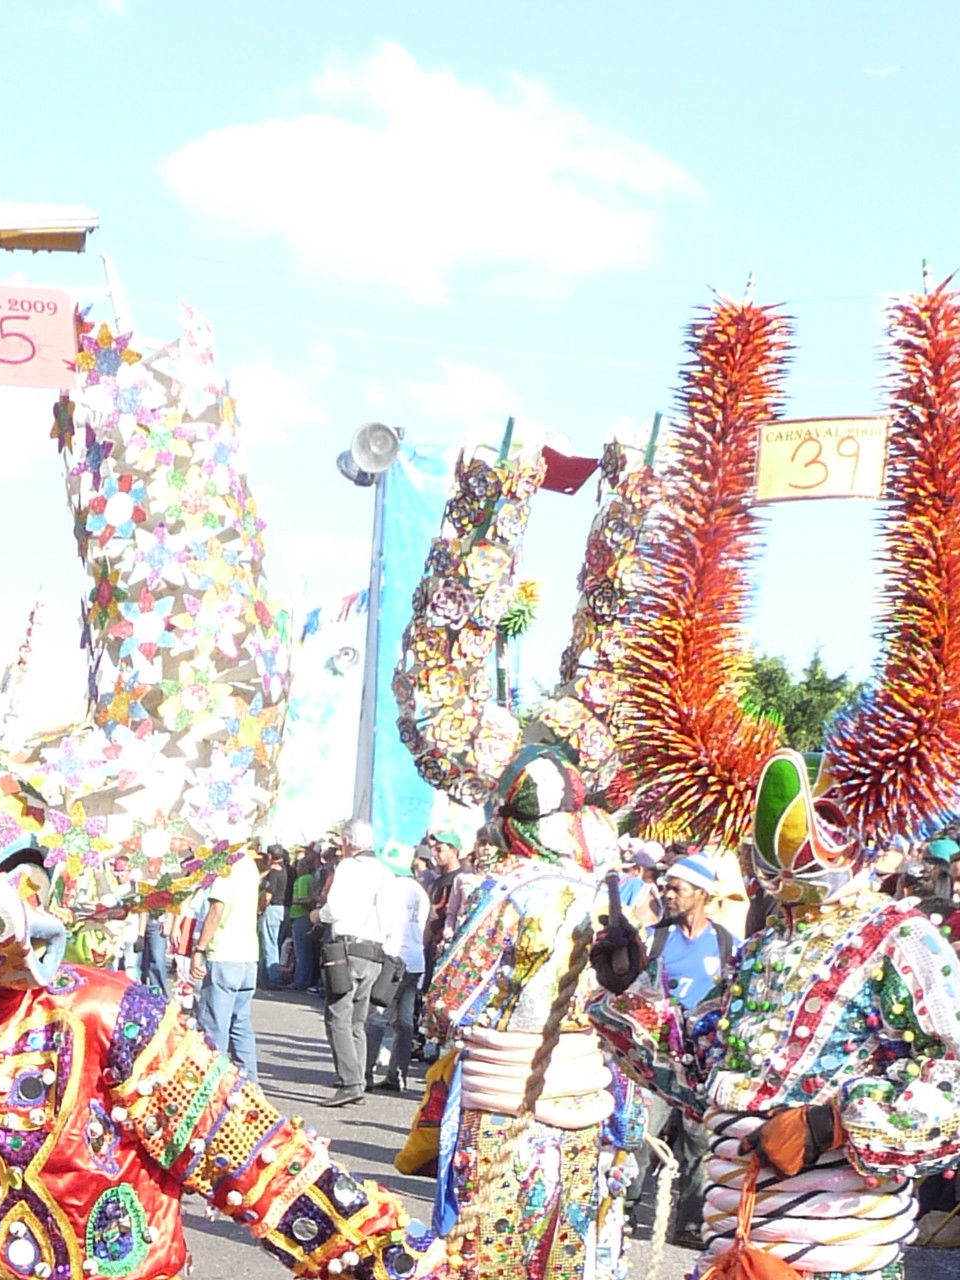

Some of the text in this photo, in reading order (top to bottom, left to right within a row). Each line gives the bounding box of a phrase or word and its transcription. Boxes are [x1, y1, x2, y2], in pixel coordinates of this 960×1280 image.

[7, 297, 58, 316] 2009
[765, 427, 841, 443] CARNAVAL
[788, 434, 860, 491] 39
[679, 977, 694, 998] 7
